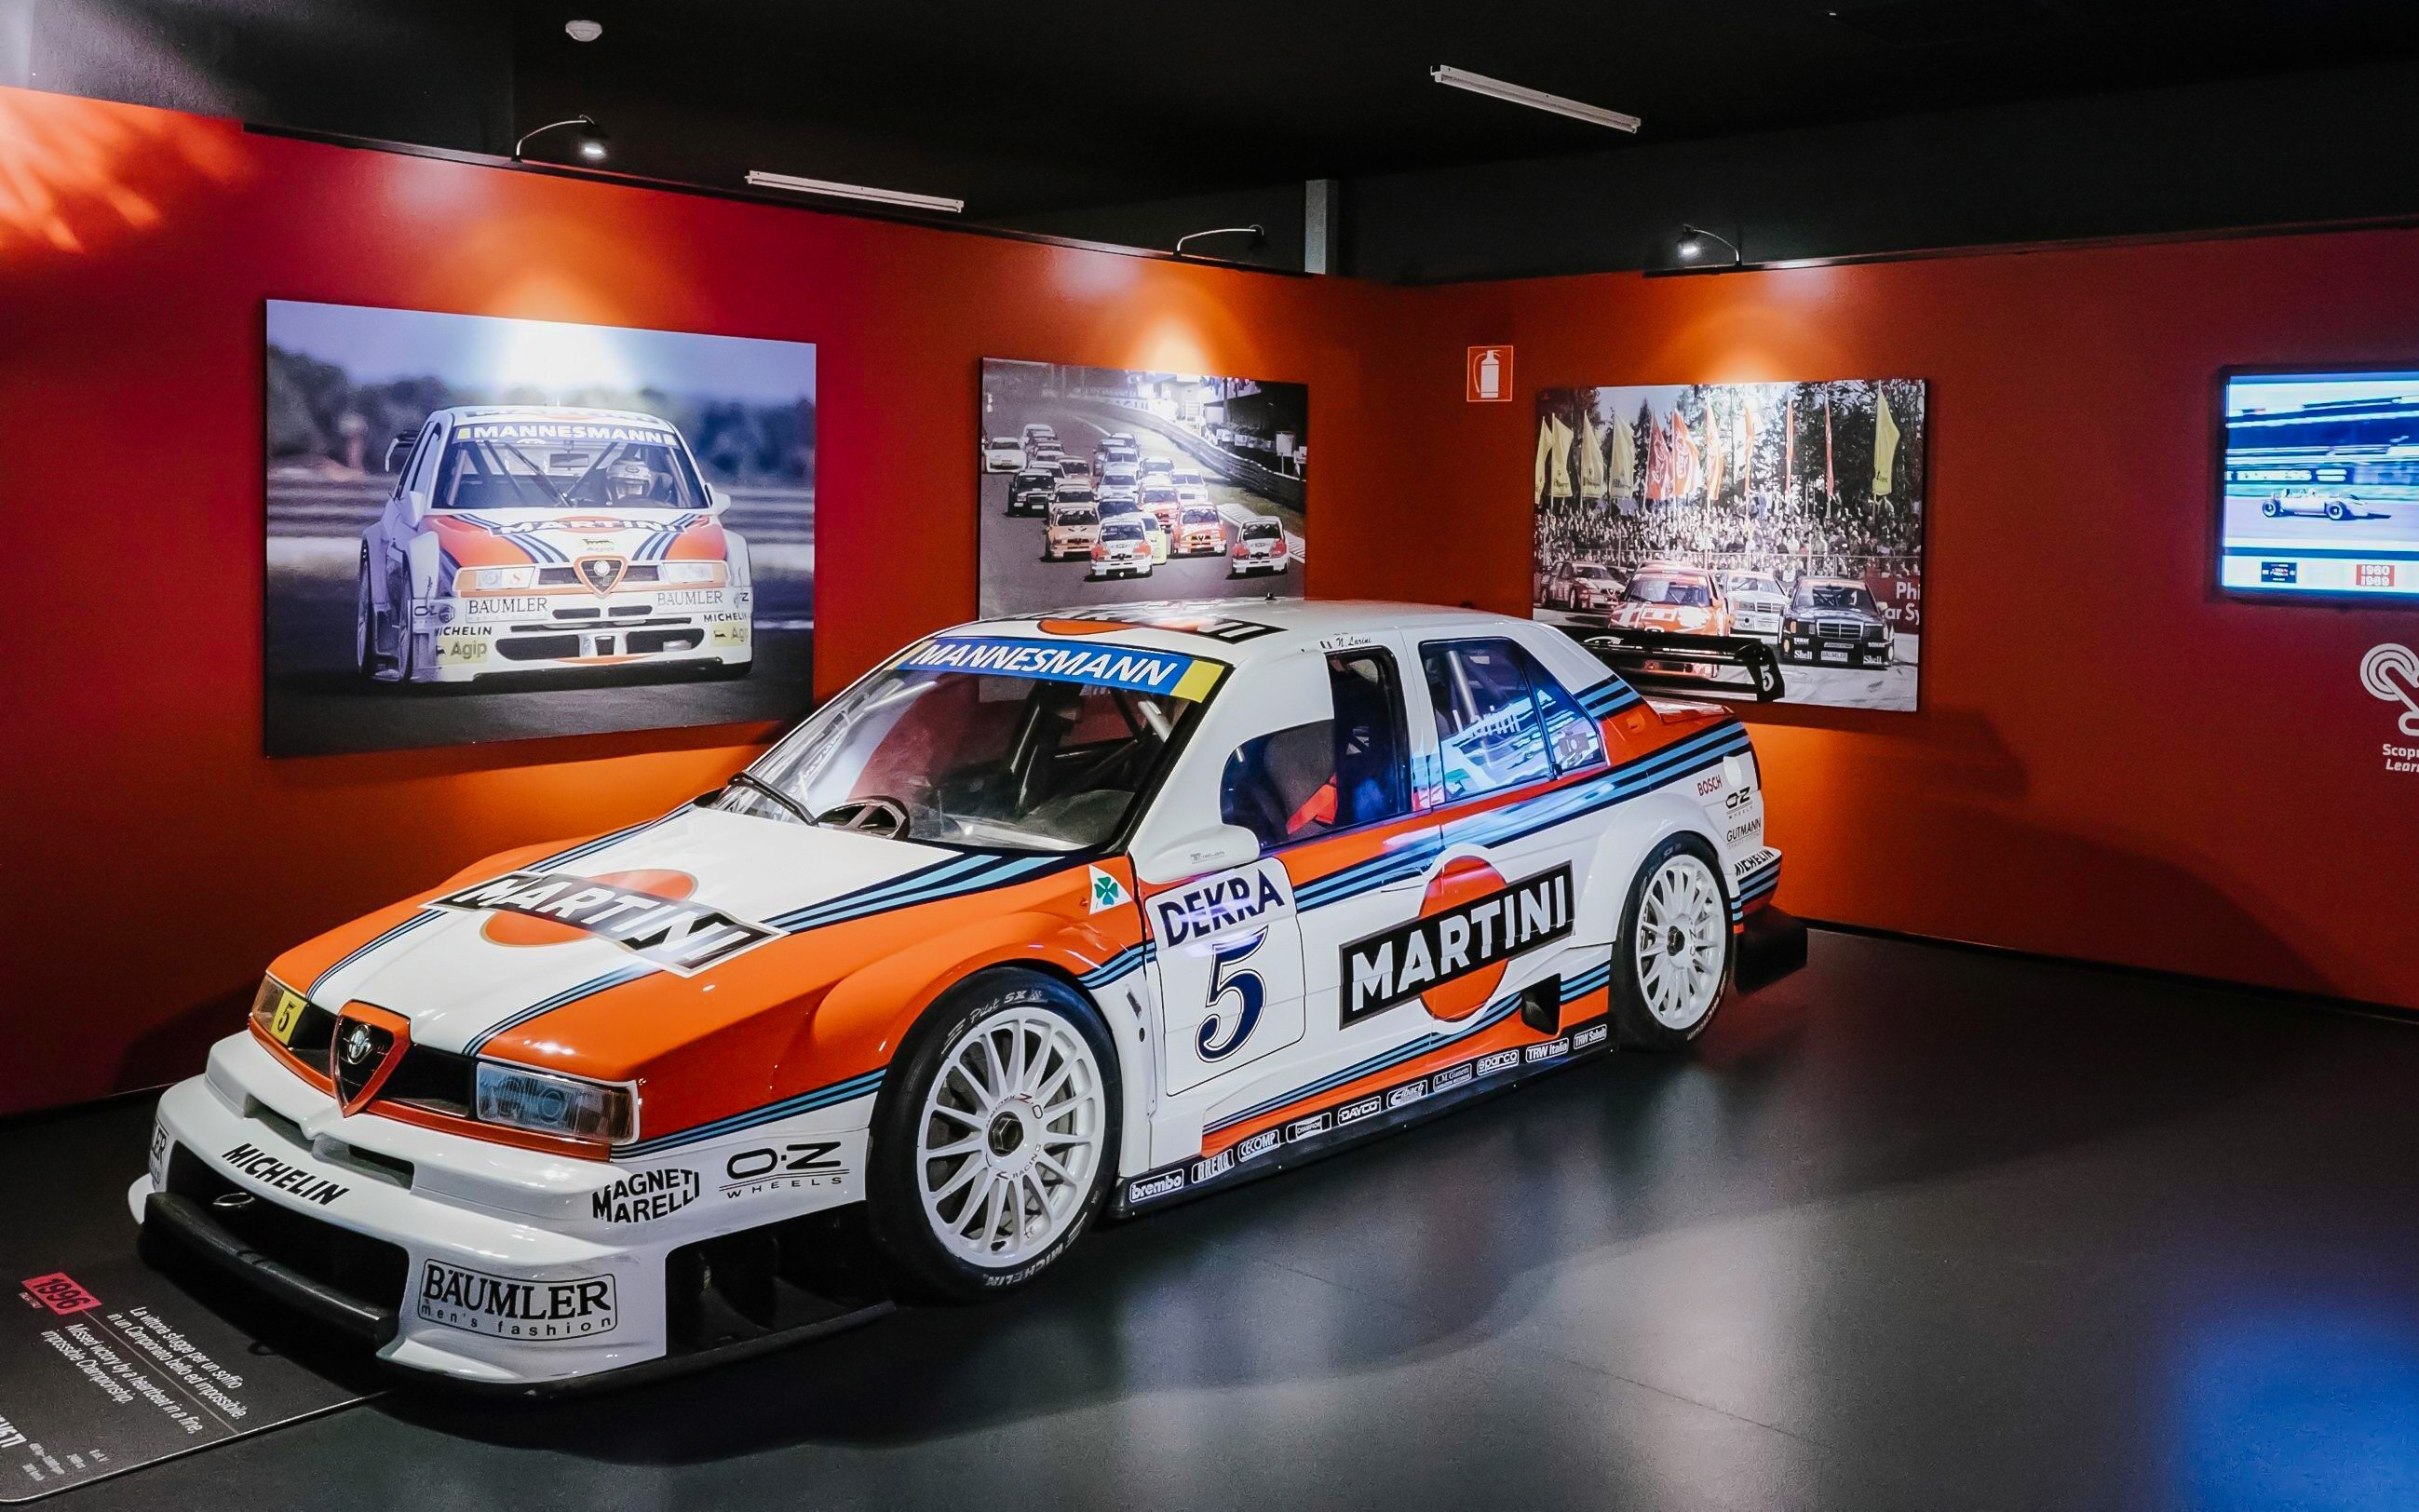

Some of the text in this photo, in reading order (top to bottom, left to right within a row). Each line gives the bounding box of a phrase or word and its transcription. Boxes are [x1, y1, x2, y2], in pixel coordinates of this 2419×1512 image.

[474, 425, 665, 445] MANNESMANN
[498, 520, 680, 534] MARTINI
[450, 641, 488, 660] Agip
[1793, 650, 1812, 661] Shell
[1863, 655, 1883, 665] Shell
[910, 644, 1177, 687] MANNESMANN
[1760, 665, 1775, 692] 5
[1696, 775, 1722, 796] BOSCH
[1726, 817, 1761, 842] GUTMANN
[1734, 849, 1774, 876] MICHELIN
[453, 875, 750, 961] MARTINI
[1157, 869, 1285, 948] DEKRA
[1352, 876, 1569, 1012] MARTINI
[1195, 925, 1269, 1063] 5
[277, 1001, 297, 1033] 5
[1527, 1041, 1568, 1060] TRW Italia
[1574, 1033, 1588, 1047] TRW
[1479, 1051, 1518, 1072] sparco
[1341, 1101, 1379, 1121] DAYCO
[1240, 1133, 1277, 1157] CECOMP
[222, 1142, 351, 1206] MICHELIN
[1131, 1173, 1182, 1199] brembo
[727, 1176, 843, 1199] WHEELS
[985, 1242, 1063, 1286] MICHELIN
[33, 1278, 91, 1309] 1996
[422, 1262, 612, 1320] BÄUMLER
[65, 1323, 104, 1346] Missed
[496, 1316, 612, 1337] fashion
[41, 1329, 87, 1361] impossible
[90, 1345, 123, 1365] victory
[129, 1306, 243, 1388] La vittoria sfugge per un soffio
[107, 1313, 247, 1420] in un Campionato bello ed impossibile.
[112, 1362, 132, 1373] by
[128, 1375, 175, 1407] heartbeat
[163, 1403, 182, 1413] in
[170, 1411, 188, 1420] a
